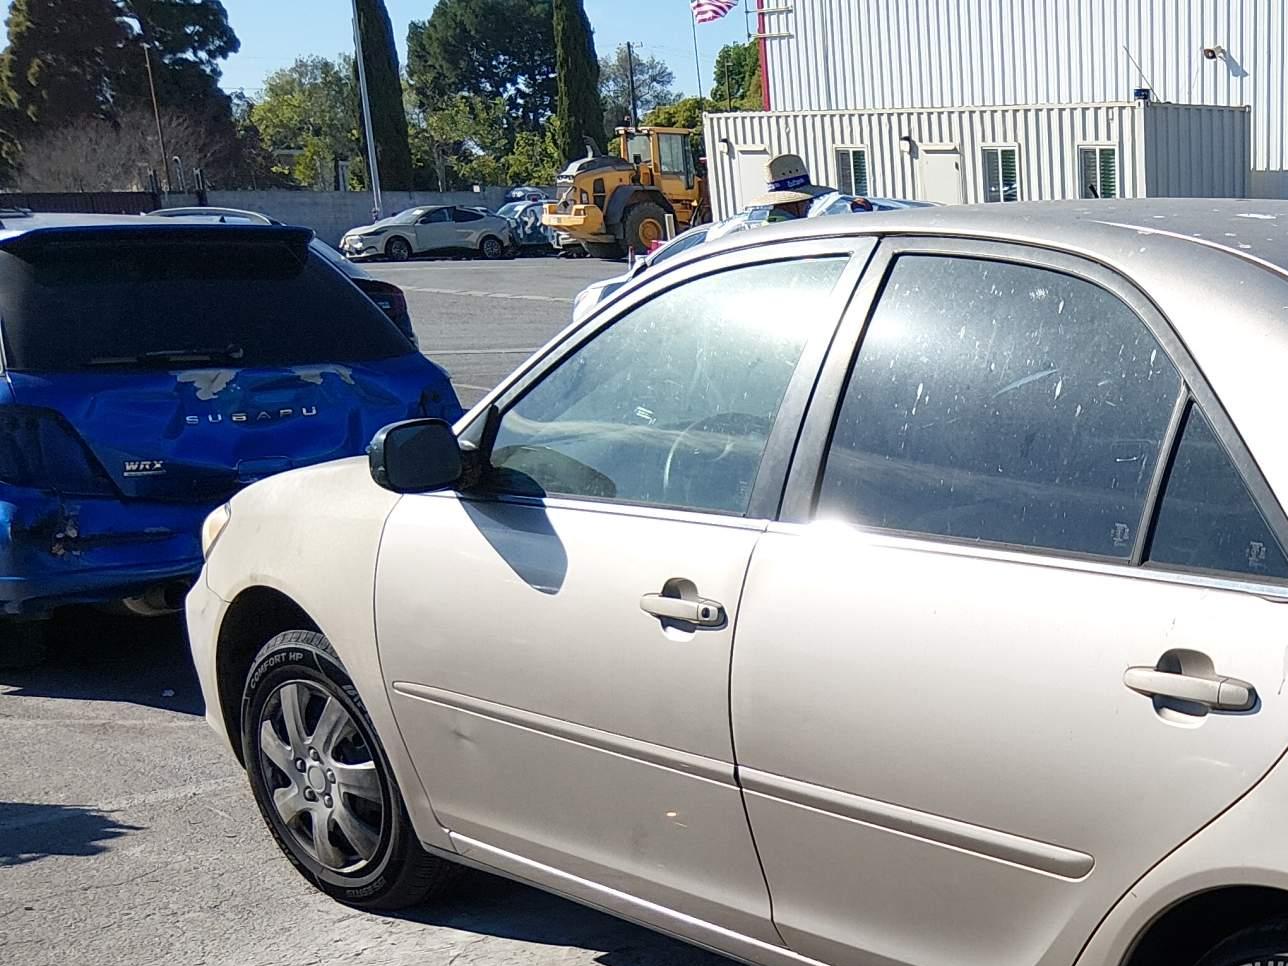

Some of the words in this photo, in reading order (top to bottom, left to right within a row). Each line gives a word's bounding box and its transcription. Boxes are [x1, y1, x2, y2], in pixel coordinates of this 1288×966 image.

[185, 405, 318, 425] SUBARU
[124, 460, 165, 473] WRX
[250, 652, 287, 689] COMFORT
[289, 651, 304, 662] HP
